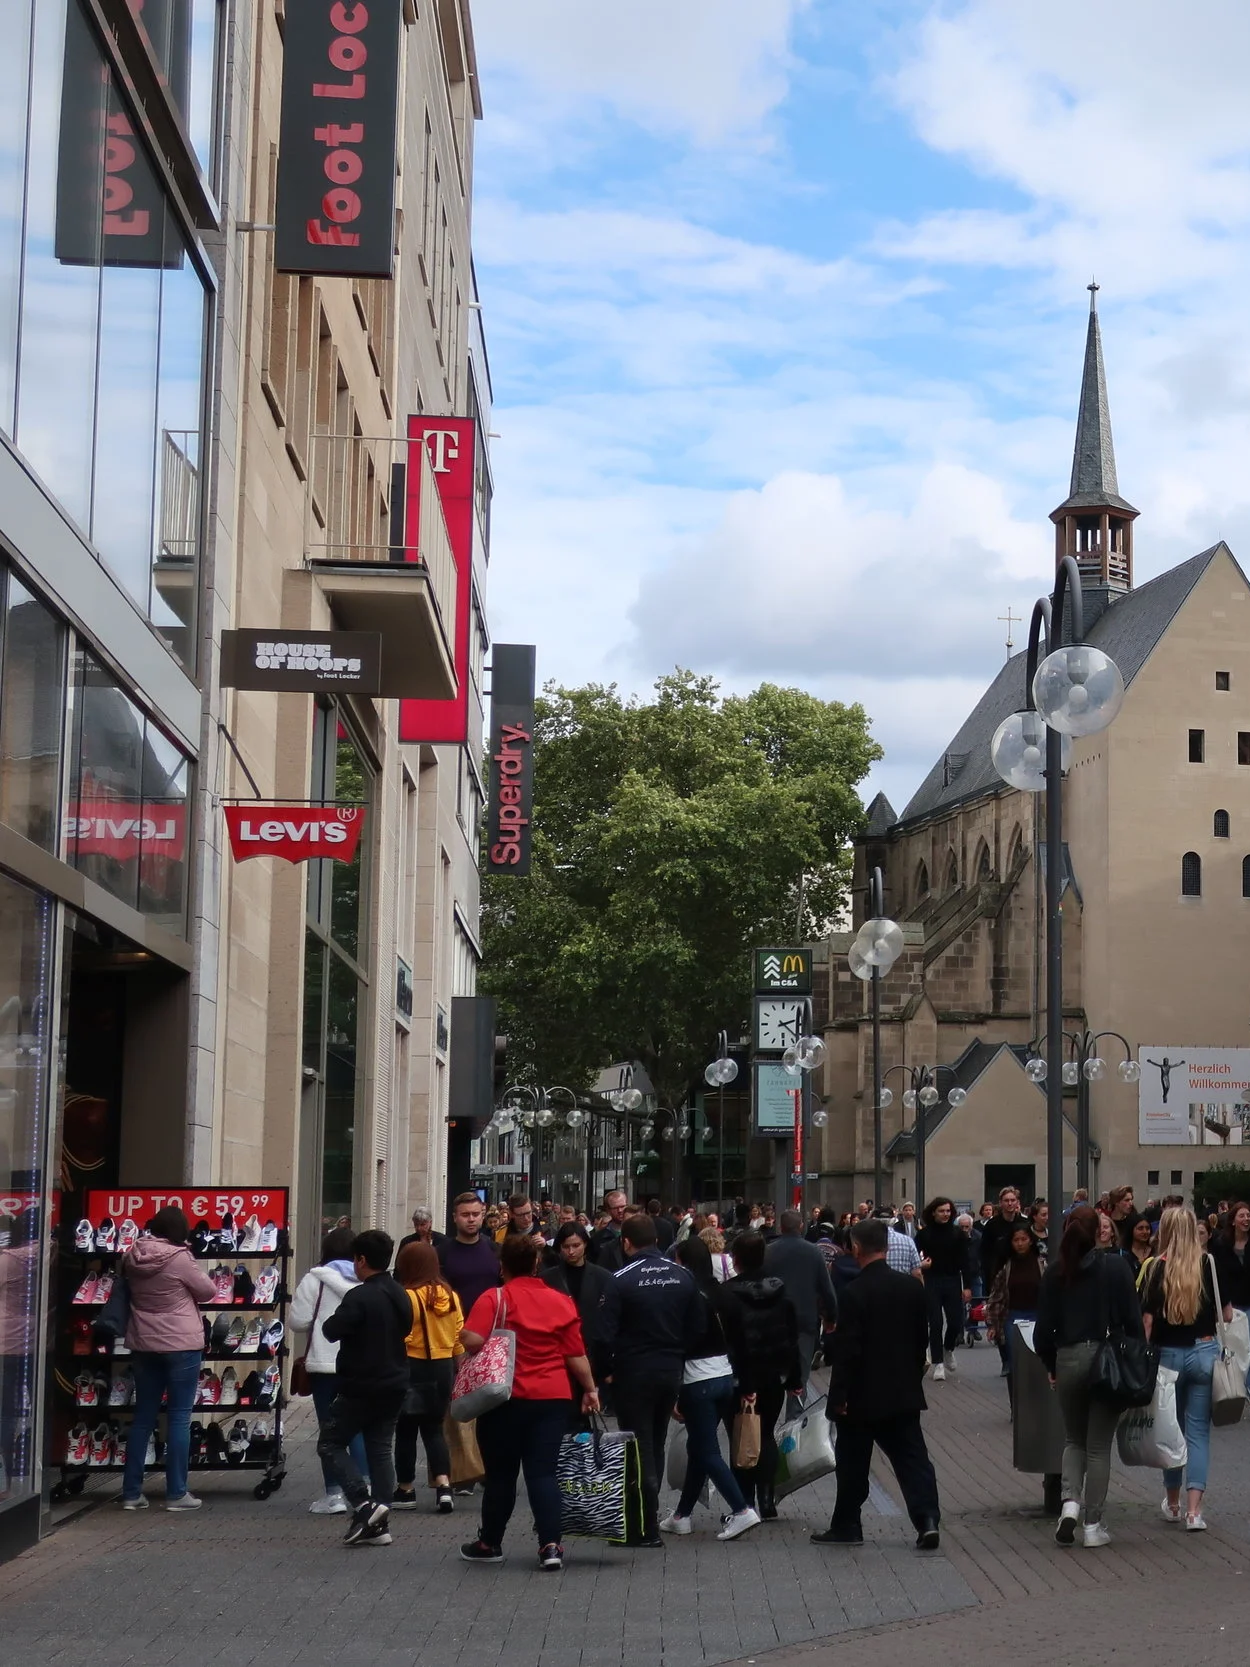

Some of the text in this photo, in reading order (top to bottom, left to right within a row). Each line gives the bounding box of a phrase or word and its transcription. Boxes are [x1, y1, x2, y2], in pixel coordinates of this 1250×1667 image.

[306, 123, 364, 247] Foot
[256, 642, 332, 658] HOUSE
[255, 655, 362, 672] OF HOOPS
[781, 979, 798, 987] C&A
[1188, 1063, 1232, 1075] Herzlich
[107, 1195, 144, 1217] UP
[191, 1196, 209, 1217] €
